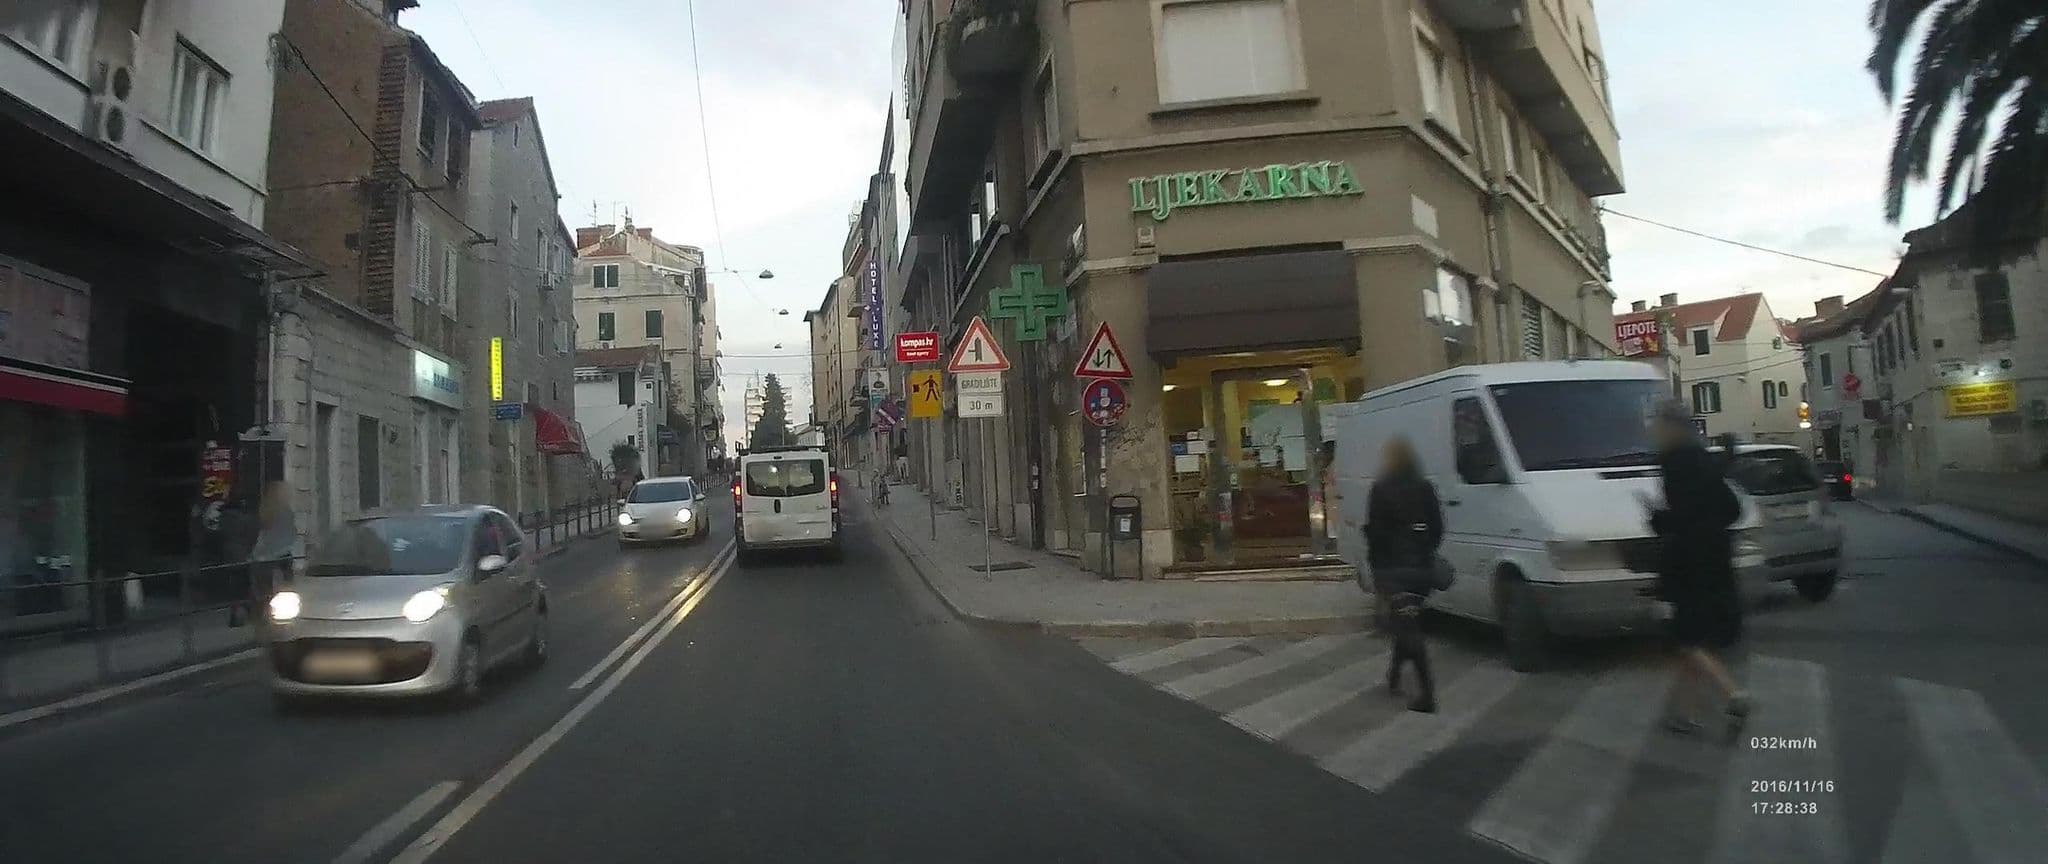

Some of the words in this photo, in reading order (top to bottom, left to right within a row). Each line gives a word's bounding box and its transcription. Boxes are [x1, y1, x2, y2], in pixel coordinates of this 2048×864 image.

[1129, 160, 1364, 221] LJEKARNA
[869, 262, 878, 303] HOTEL
[1617, 321, 1657, 339] LJEPOTE
[900, 336, 934, 349] kompas.hr
[968, 399, 982, 411] 30
[984, 402, 993, 410] m
